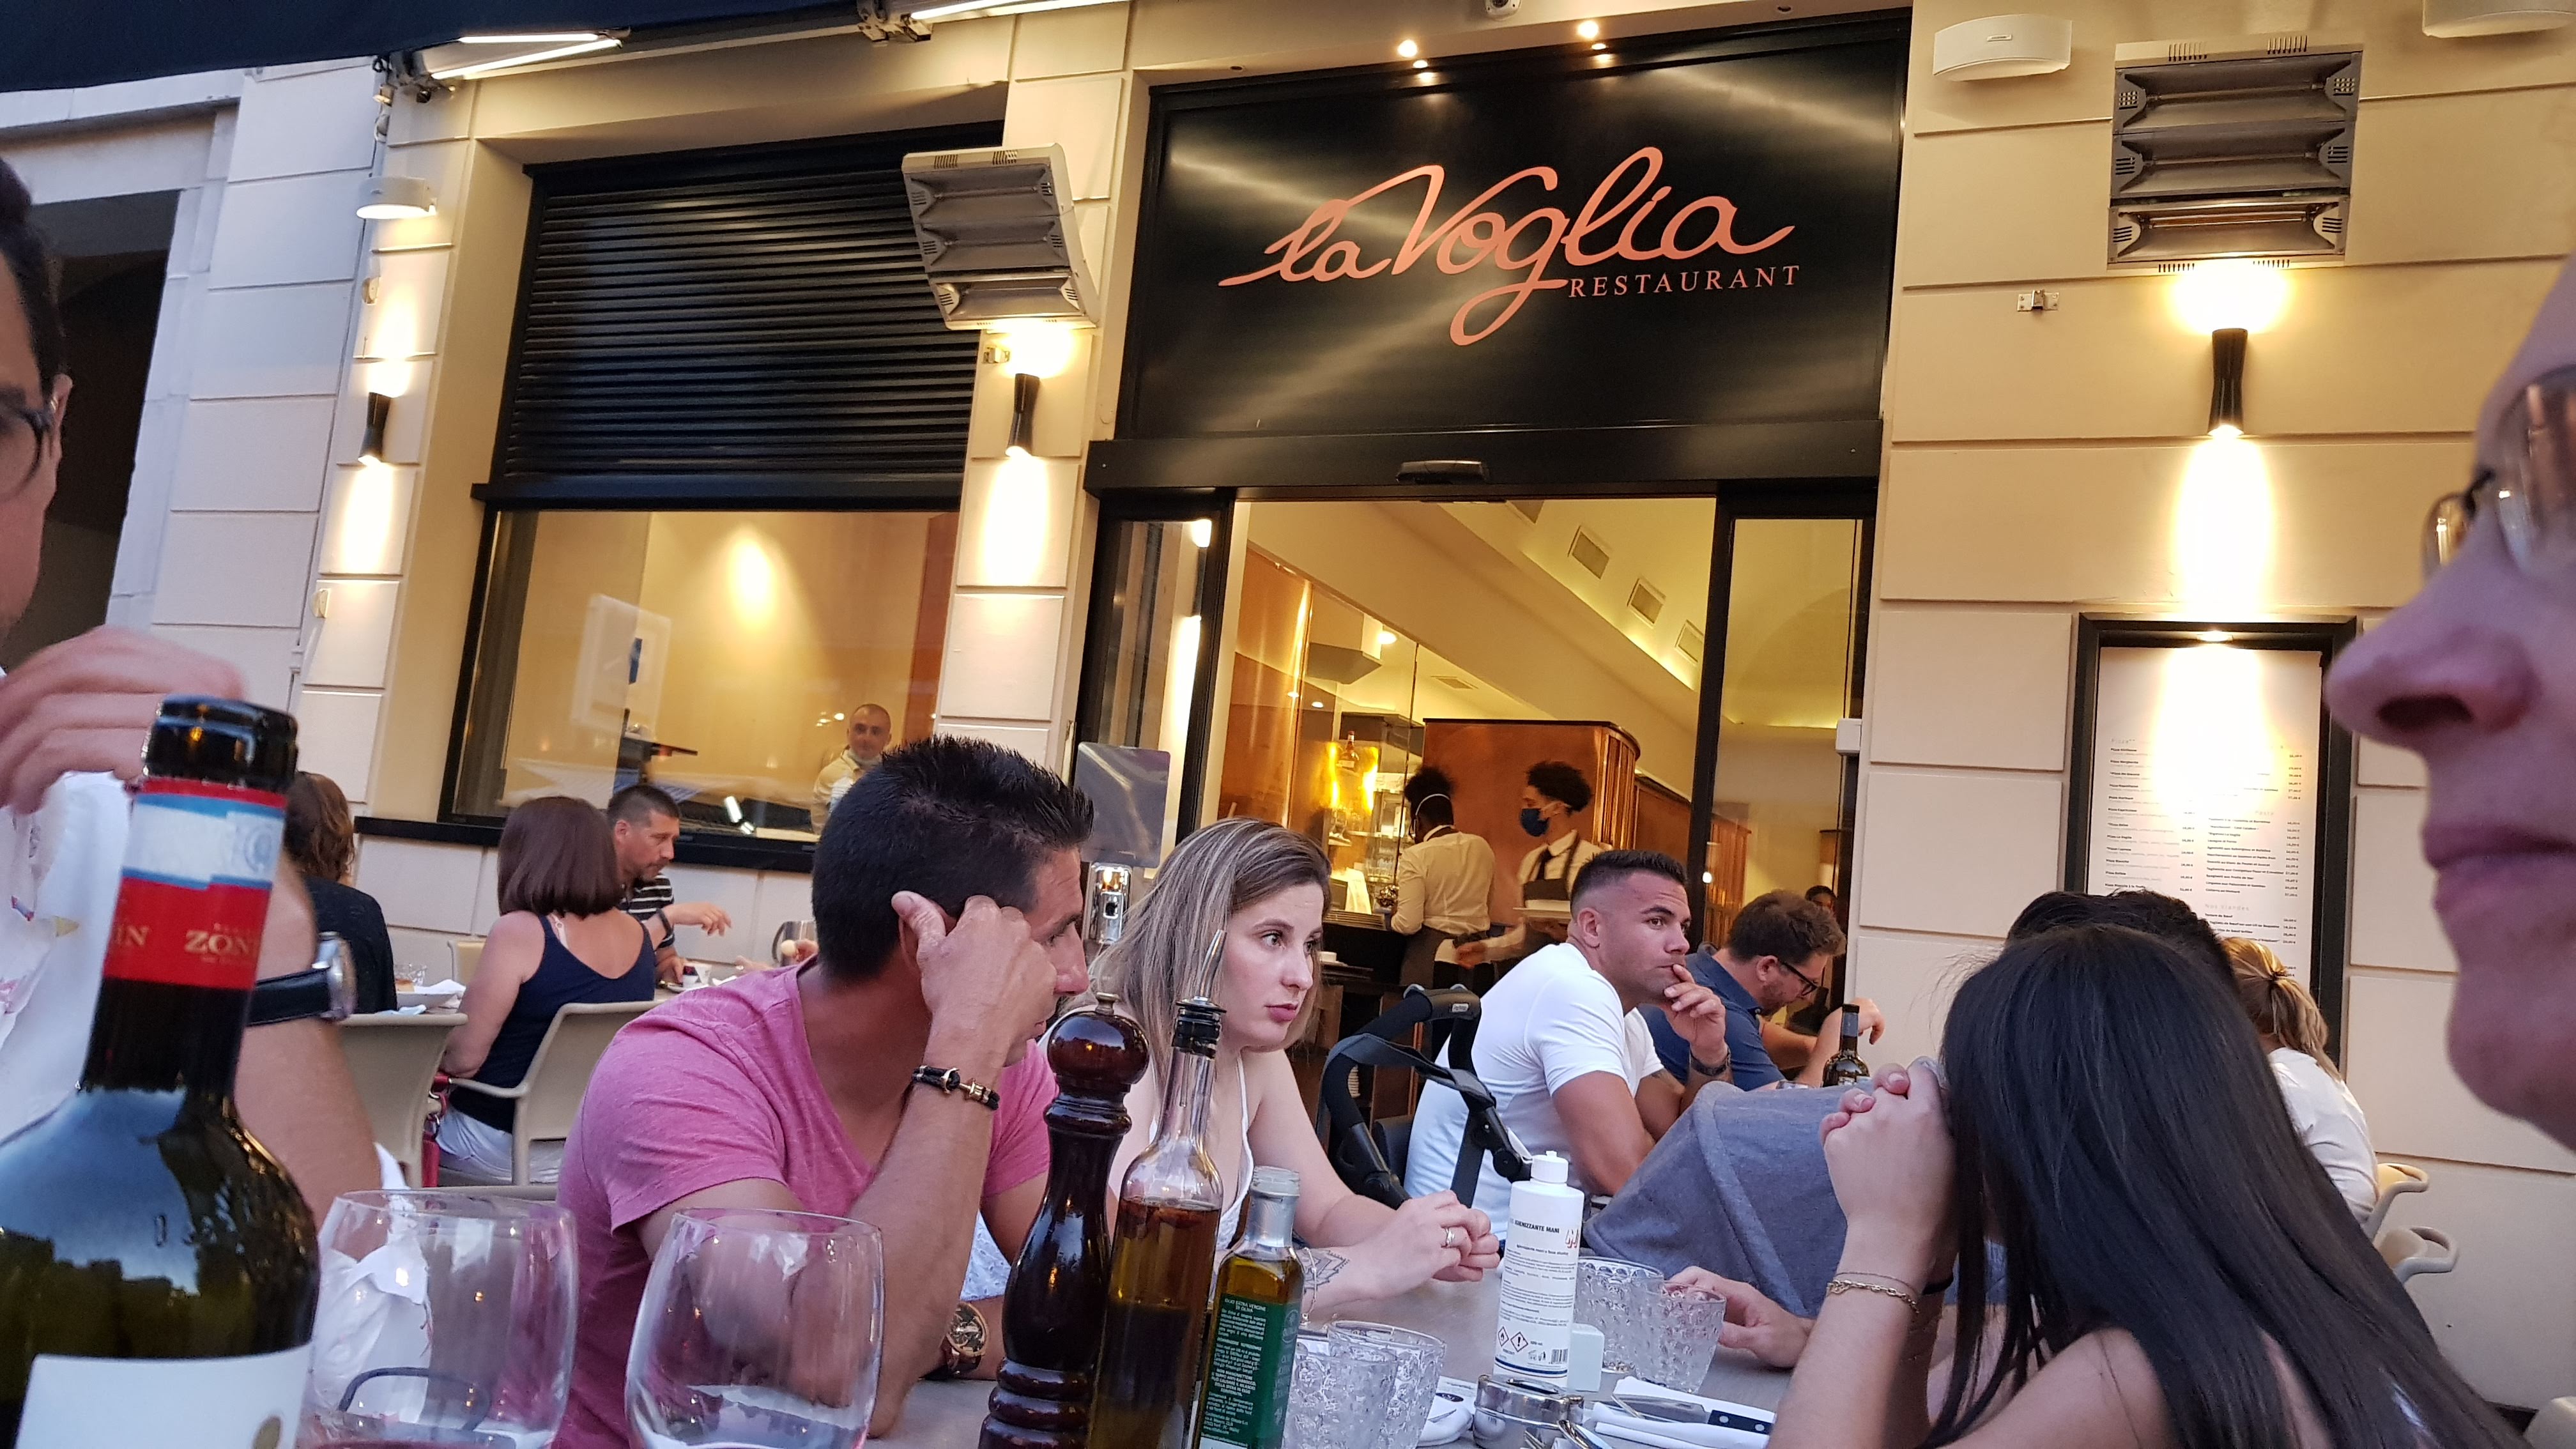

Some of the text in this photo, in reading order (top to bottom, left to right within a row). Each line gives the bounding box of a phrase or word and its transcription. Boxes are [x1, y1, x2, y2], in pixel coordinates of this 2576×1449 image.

[1218, 146, 1795, 346] la Voglia
[1568, 264, 1801, 298] RESTAURANT
